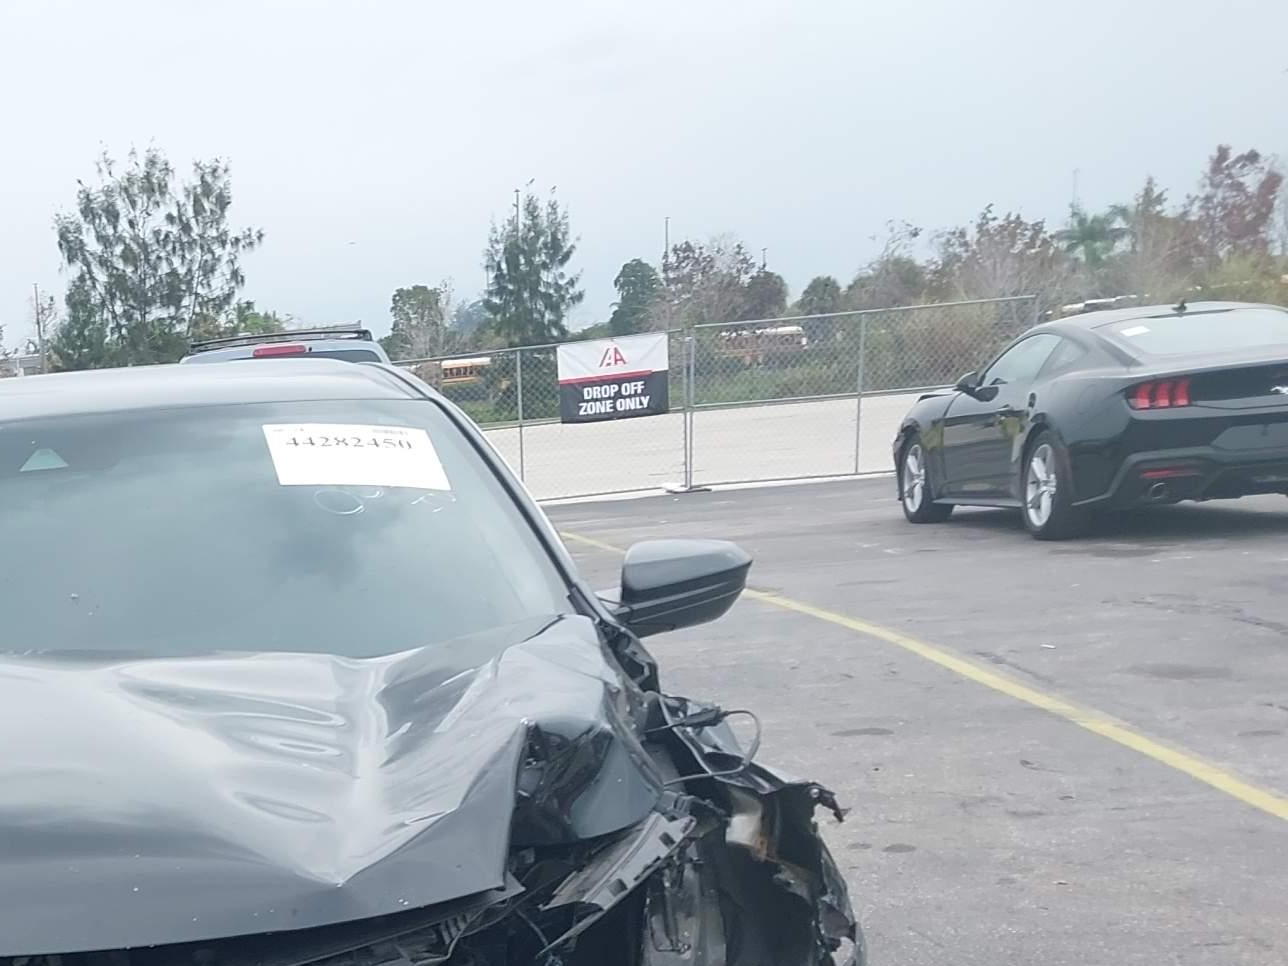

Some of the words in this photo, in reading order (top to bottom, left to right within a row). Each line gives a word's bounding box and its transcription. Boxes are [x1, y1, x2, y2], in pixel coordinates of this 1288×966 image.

[583, 385, 619, 400] DROP
[621, 381, 645, 395] OFF
[578, 400, 614, 415] ZONE
[616, 396, 650, 411] ONLY
